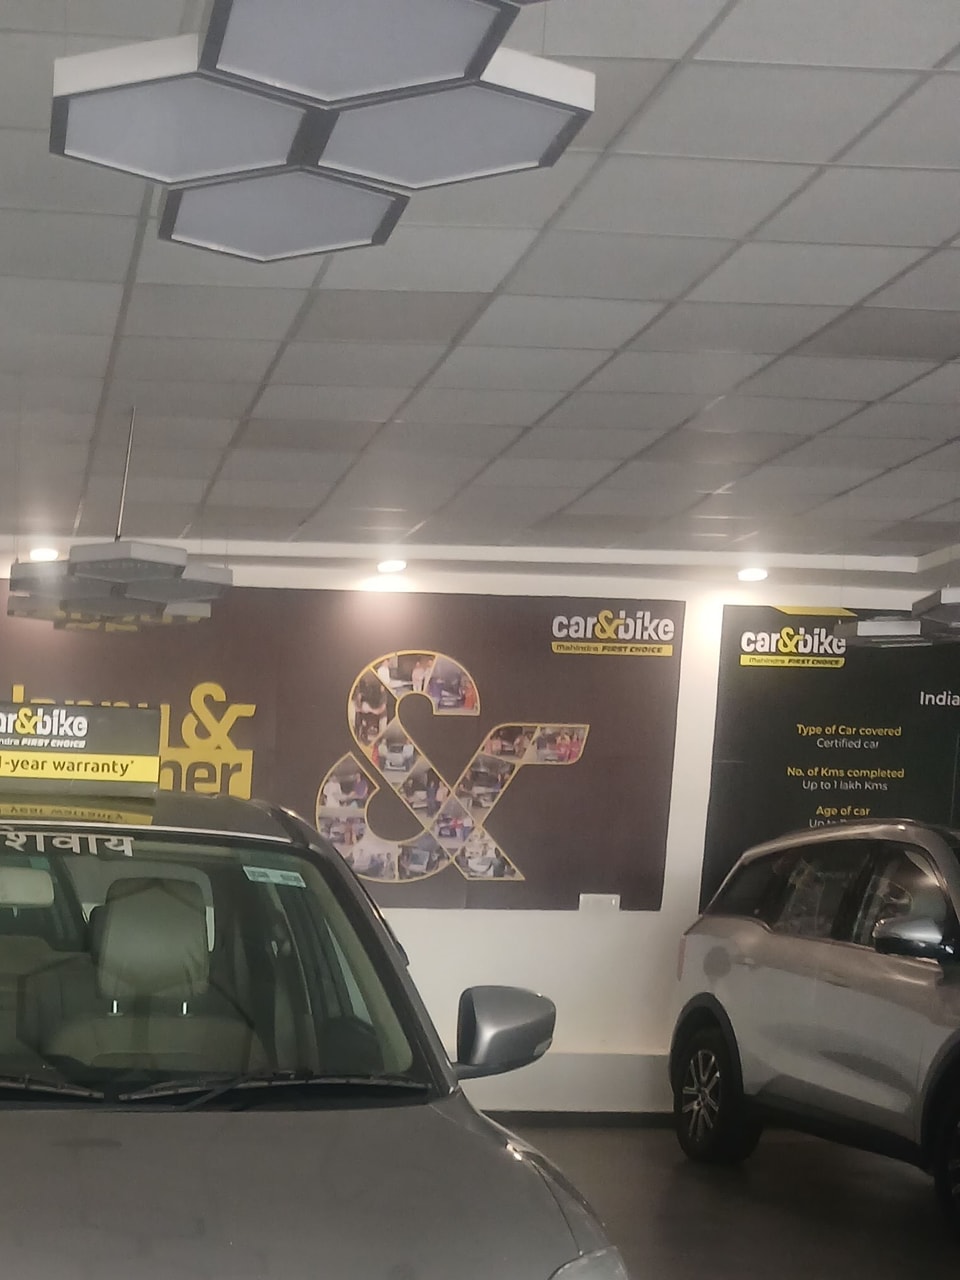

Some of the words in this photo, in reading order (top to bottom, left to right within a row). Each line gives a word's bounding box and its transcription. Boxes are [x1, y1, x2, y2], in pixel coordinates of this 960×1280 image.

[552, 610, 675, 641] car&bike
[741, 627, 846, 655] car&bike
[796, 723, 822, 736] Type
[825, 724, 836, 735] of
[838, 725, 856, 735] Car
[859, 726, 901, 736] covered
[816, 738, 860, 748] Certified
[787, 766, 804, 776] No.
[807, 767, 818, 776] of
[821, 767, 844, 777] Kms
[847, 768, 904, 779] completed
[802, 780, 818, 791] Up
[820, 781, 831, 789] to
[840, 781, 861, 790] lakh
[865, 781, 888, 790] Kms
[815, 806, 837, 817] Age
[840, 806, 851, 816] of
[853, 808, 871, 816] car
